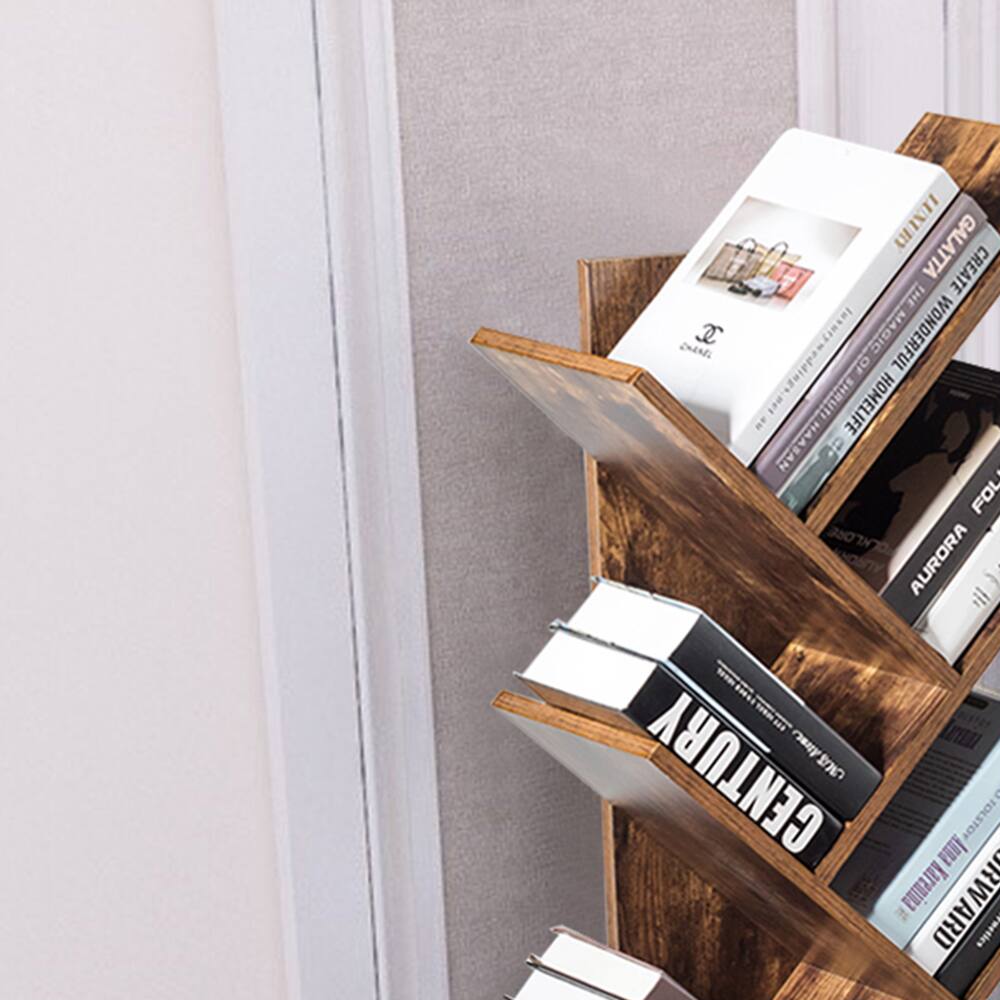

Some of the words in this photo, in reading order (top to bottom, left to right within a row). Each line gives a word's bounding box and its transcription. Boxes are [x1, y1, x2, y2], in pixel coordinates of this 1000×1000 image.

[894, 193, 940, 249] LUXURY
[922, 213, 976, 280] GALATTA
[907, 281, 925, 304] THE
[953, 245, 990, 295] CREATE
[872, 308, 907, 353] MAGIC
[891, 295, 955, 373] WONDERFUL
[855, 355, 872, 377] OF
[847, 372, 896, 438] HOMELIFE
[776, 420, 823, 474] HAASAN
[910, 523, 967, 596] AURORA
[647, 691, 824, 854] CENTURY
[962, 799, 997, 840] TOLSTOY
[937, 833, 969, 868] Anna
[901, 863, 950, 912] Karenina
